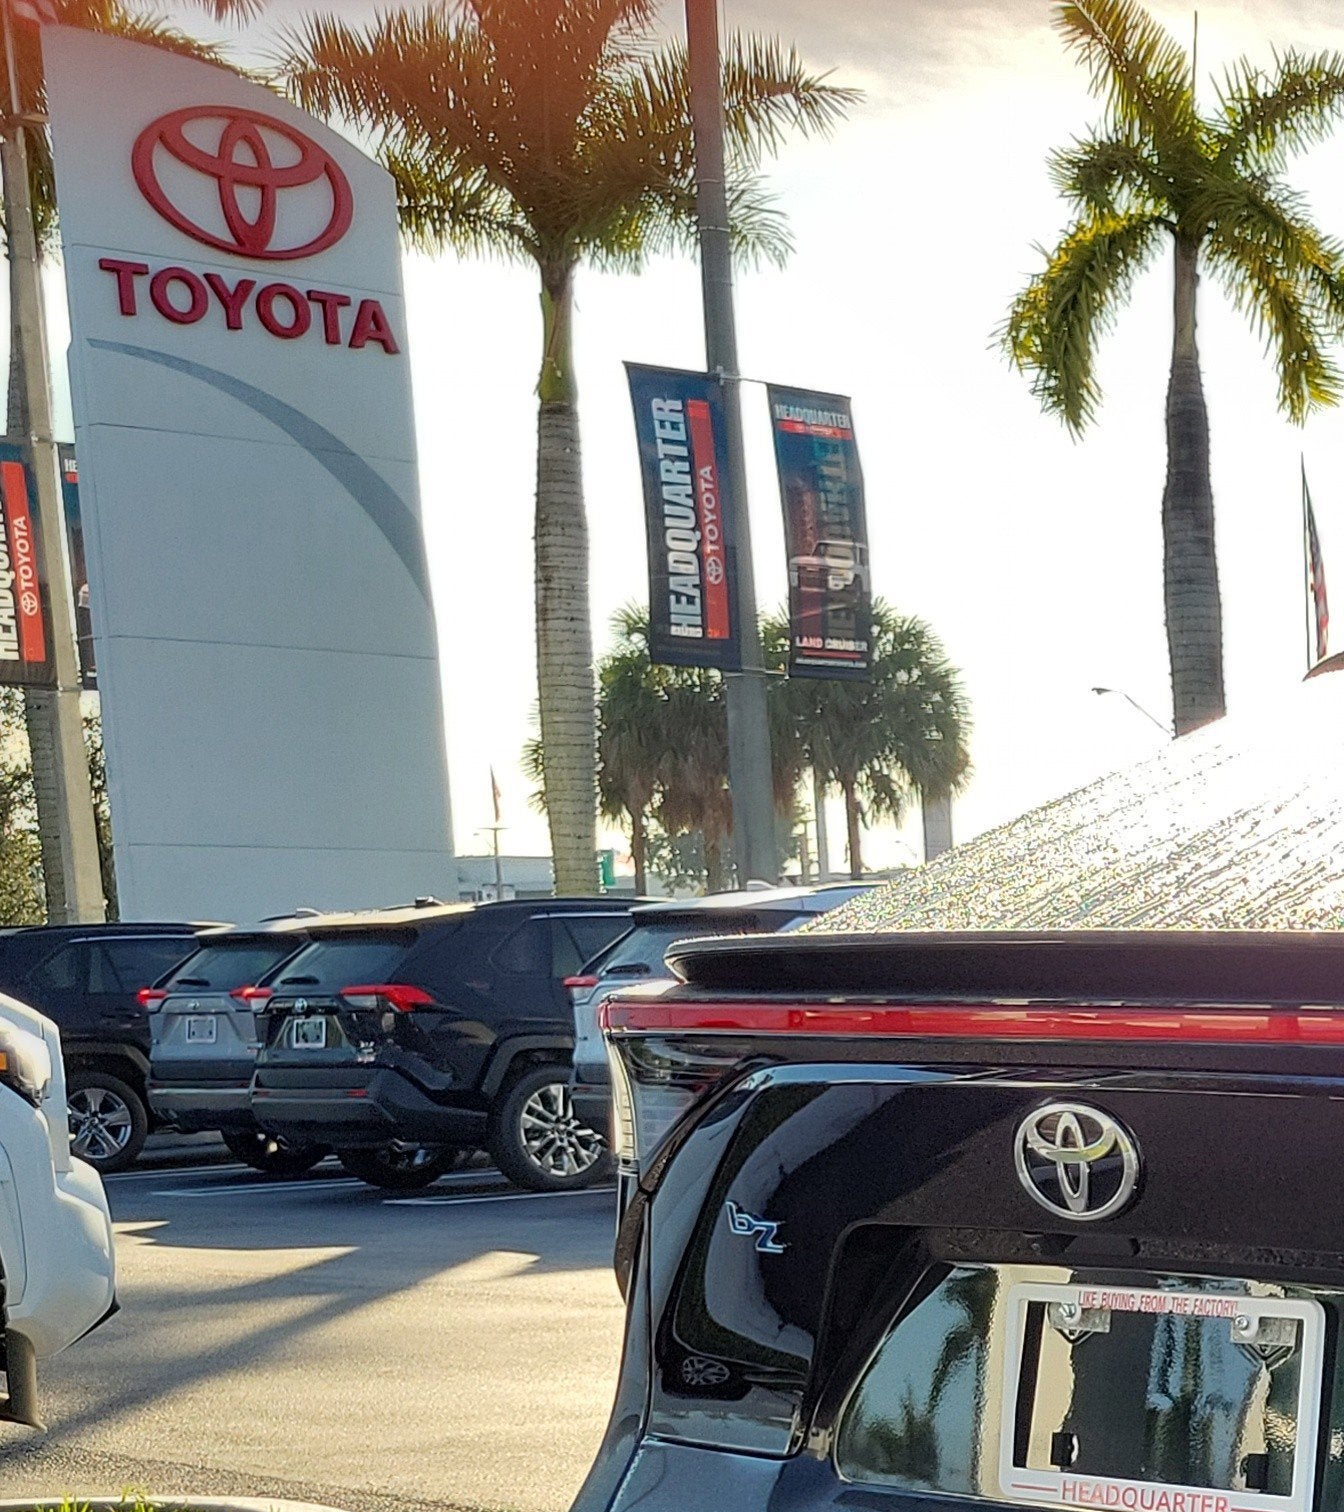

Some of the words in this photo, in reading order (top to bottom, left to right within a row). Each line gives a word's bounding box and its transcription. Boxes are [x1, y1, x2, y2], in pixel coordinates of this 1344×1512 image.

[98, 258, 400, 355] TOYOTA
[13, 515, 35, 591] TOYOTA
[652, 397, 704, 638] HEADQUARTER
[699, 465, 720, 553] TOYOTA
[1078, 1290, 1097, 1309] LIKE
[1101, 1291, 1135, 1312] BUYING
[1140, 1294, 1166, 1314] FROM
[1171, 1297, 1188, 1314] THE
